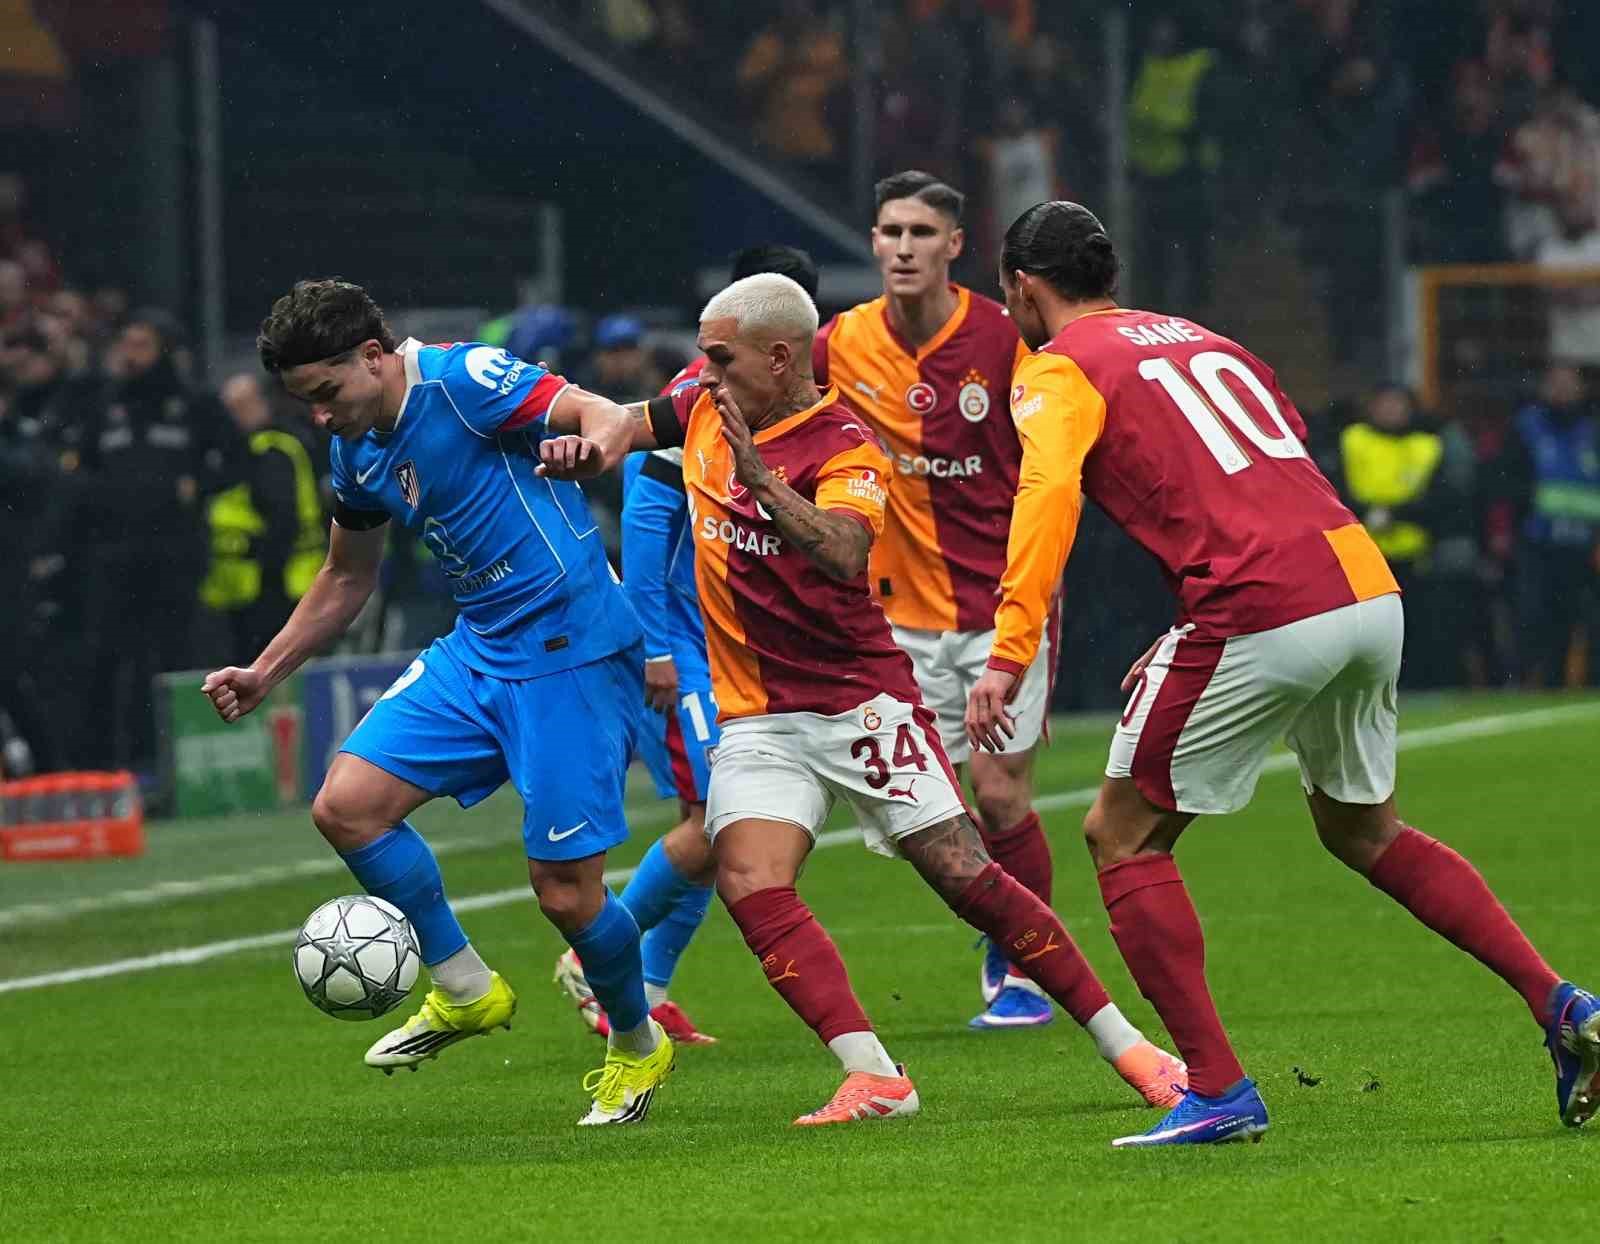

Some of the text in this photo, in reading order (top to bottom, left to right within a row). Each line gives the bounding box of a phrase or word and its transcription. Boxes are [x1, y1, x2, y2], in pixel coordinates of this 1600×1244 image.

[1116, 317, 1204, 346] SANÉ
[1137, 350, 1305, 475] 10
[898, 454, 982, 478] SOCAR
[700, 516, 782, 556] SOCAR
[850, 722, 929, 789] 34
